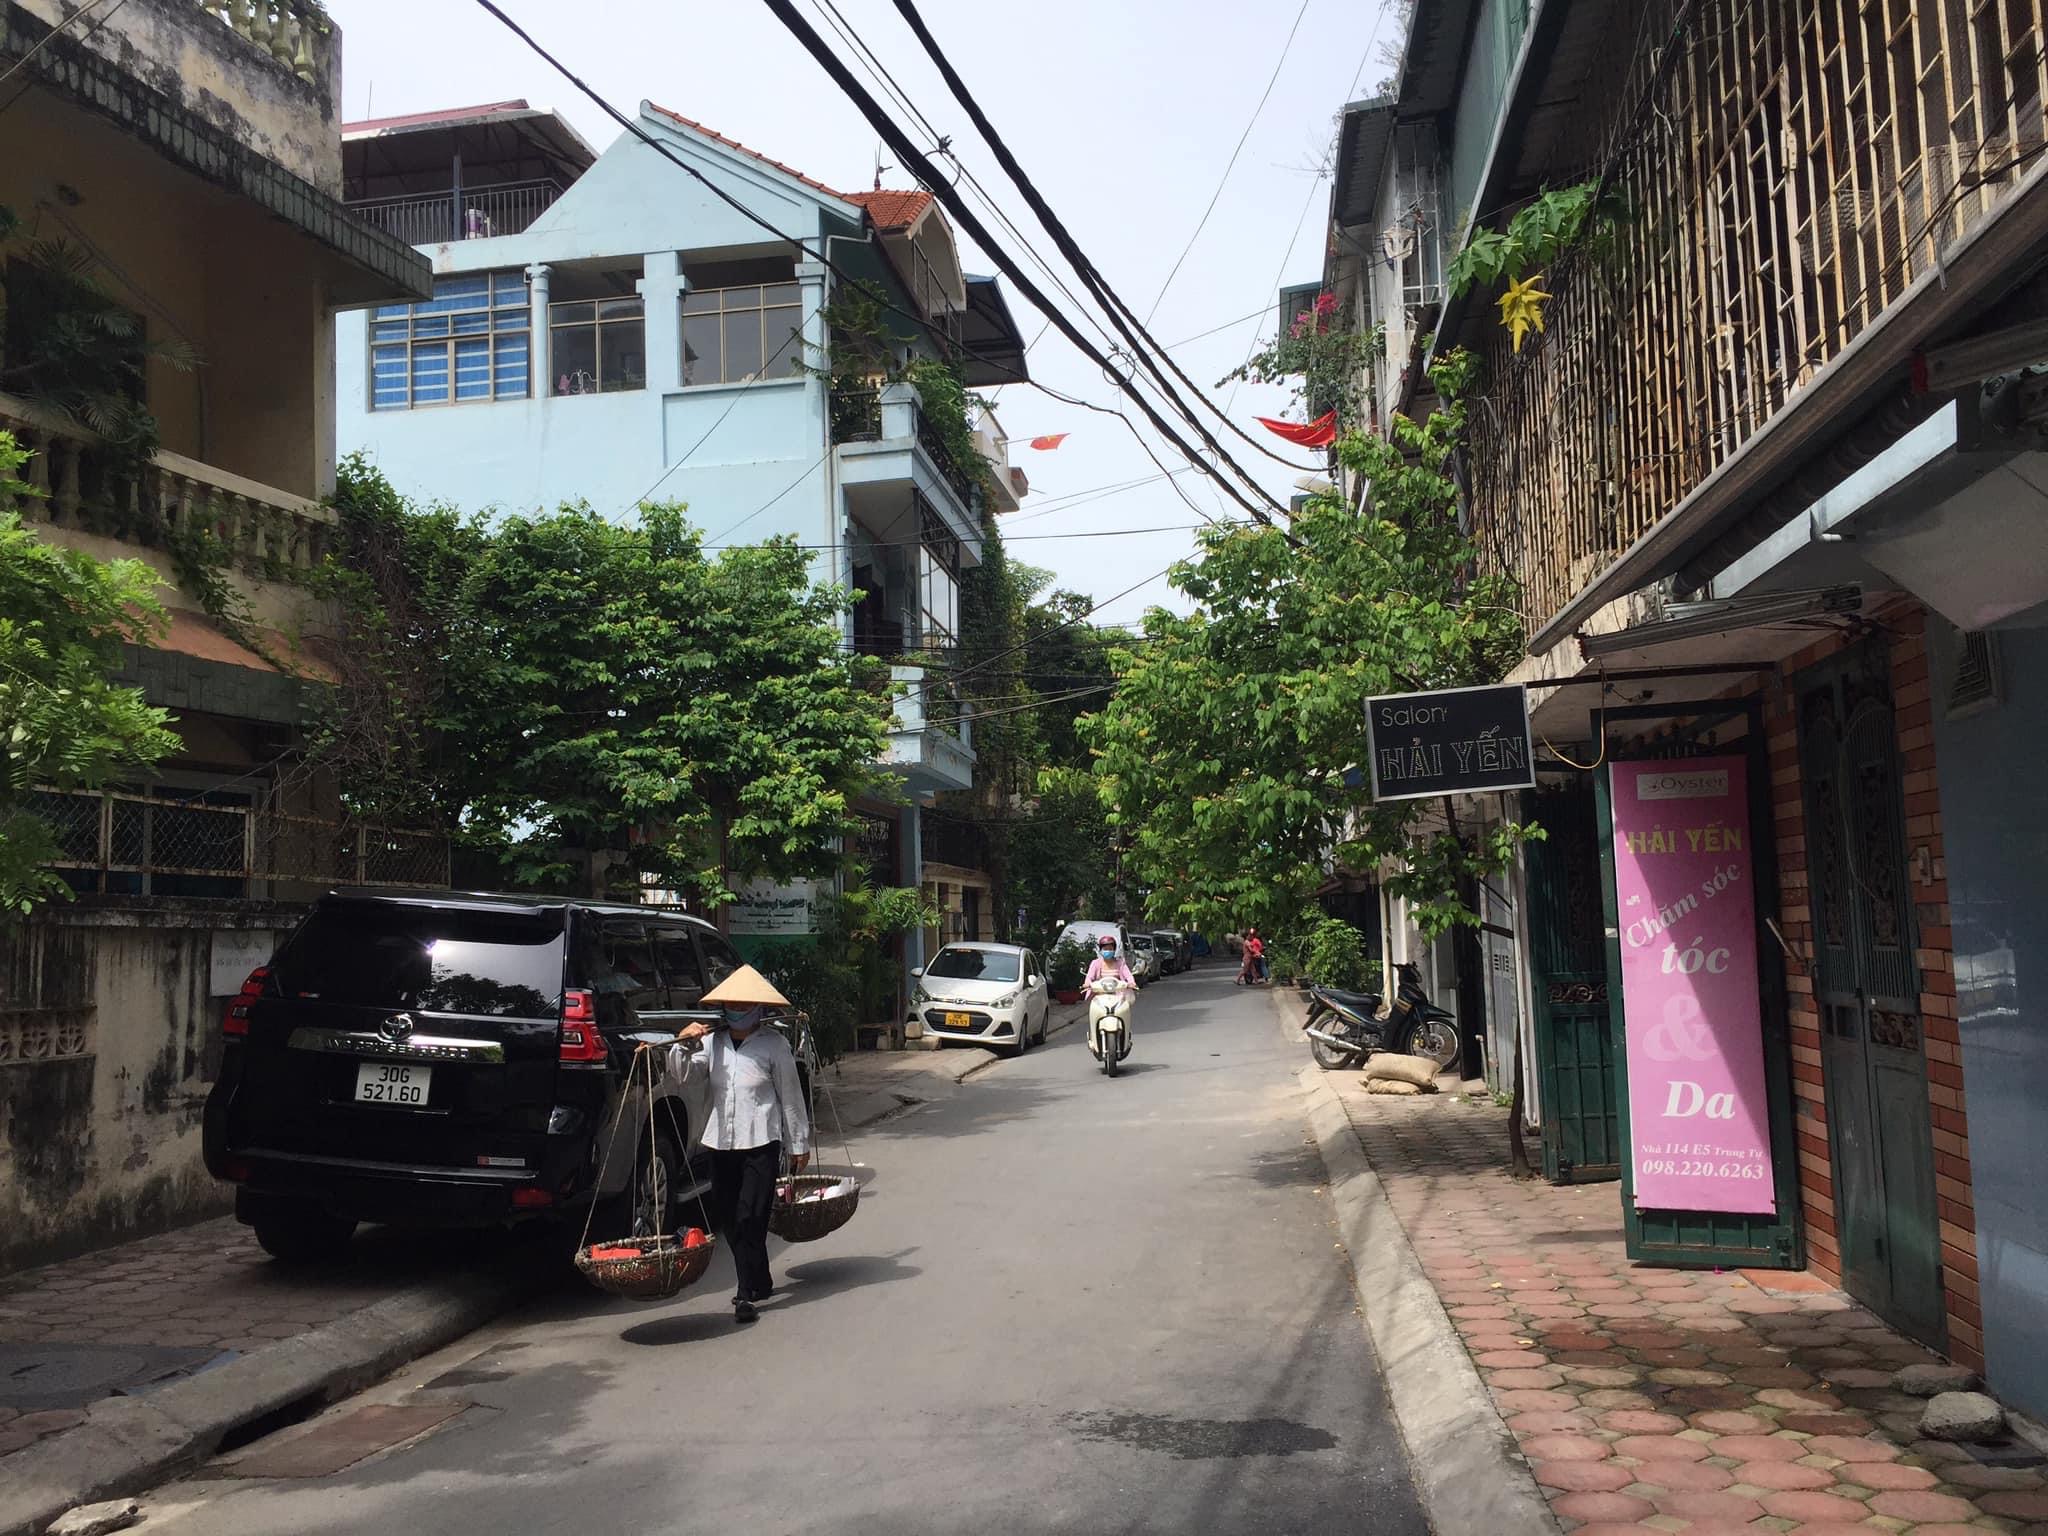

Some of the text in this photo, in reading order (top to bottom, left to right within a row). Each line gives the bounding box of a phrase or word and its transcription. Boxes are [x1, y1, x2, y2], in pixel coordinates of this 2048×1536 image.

[1381, 705, 1446, 727] Salon
[1380, 725, 1527, 781] HẢI YẾN
[1661, 774, 1725, 792] Oyster
[1626, 817, 1743, 854] HẢI YẾN
[1626, 864, 1740, 948] Chăm sóc
[1661, 936, 1730, 974] tóc
[1643, 993, 1719, 1061] &
[378, 1066, 410, 1083] 30G
[363, 1083, 421, 1102] 521.60
[1661, 1080, 1736, 1119] Da
[1665, 1143, 1689, 1154] 114
[1692, 1143, 1711, 1156] E5
[1714, 1147, 1745, 1159] Trung
[1642, 1159, 1764, 1180] 098.220.6263
